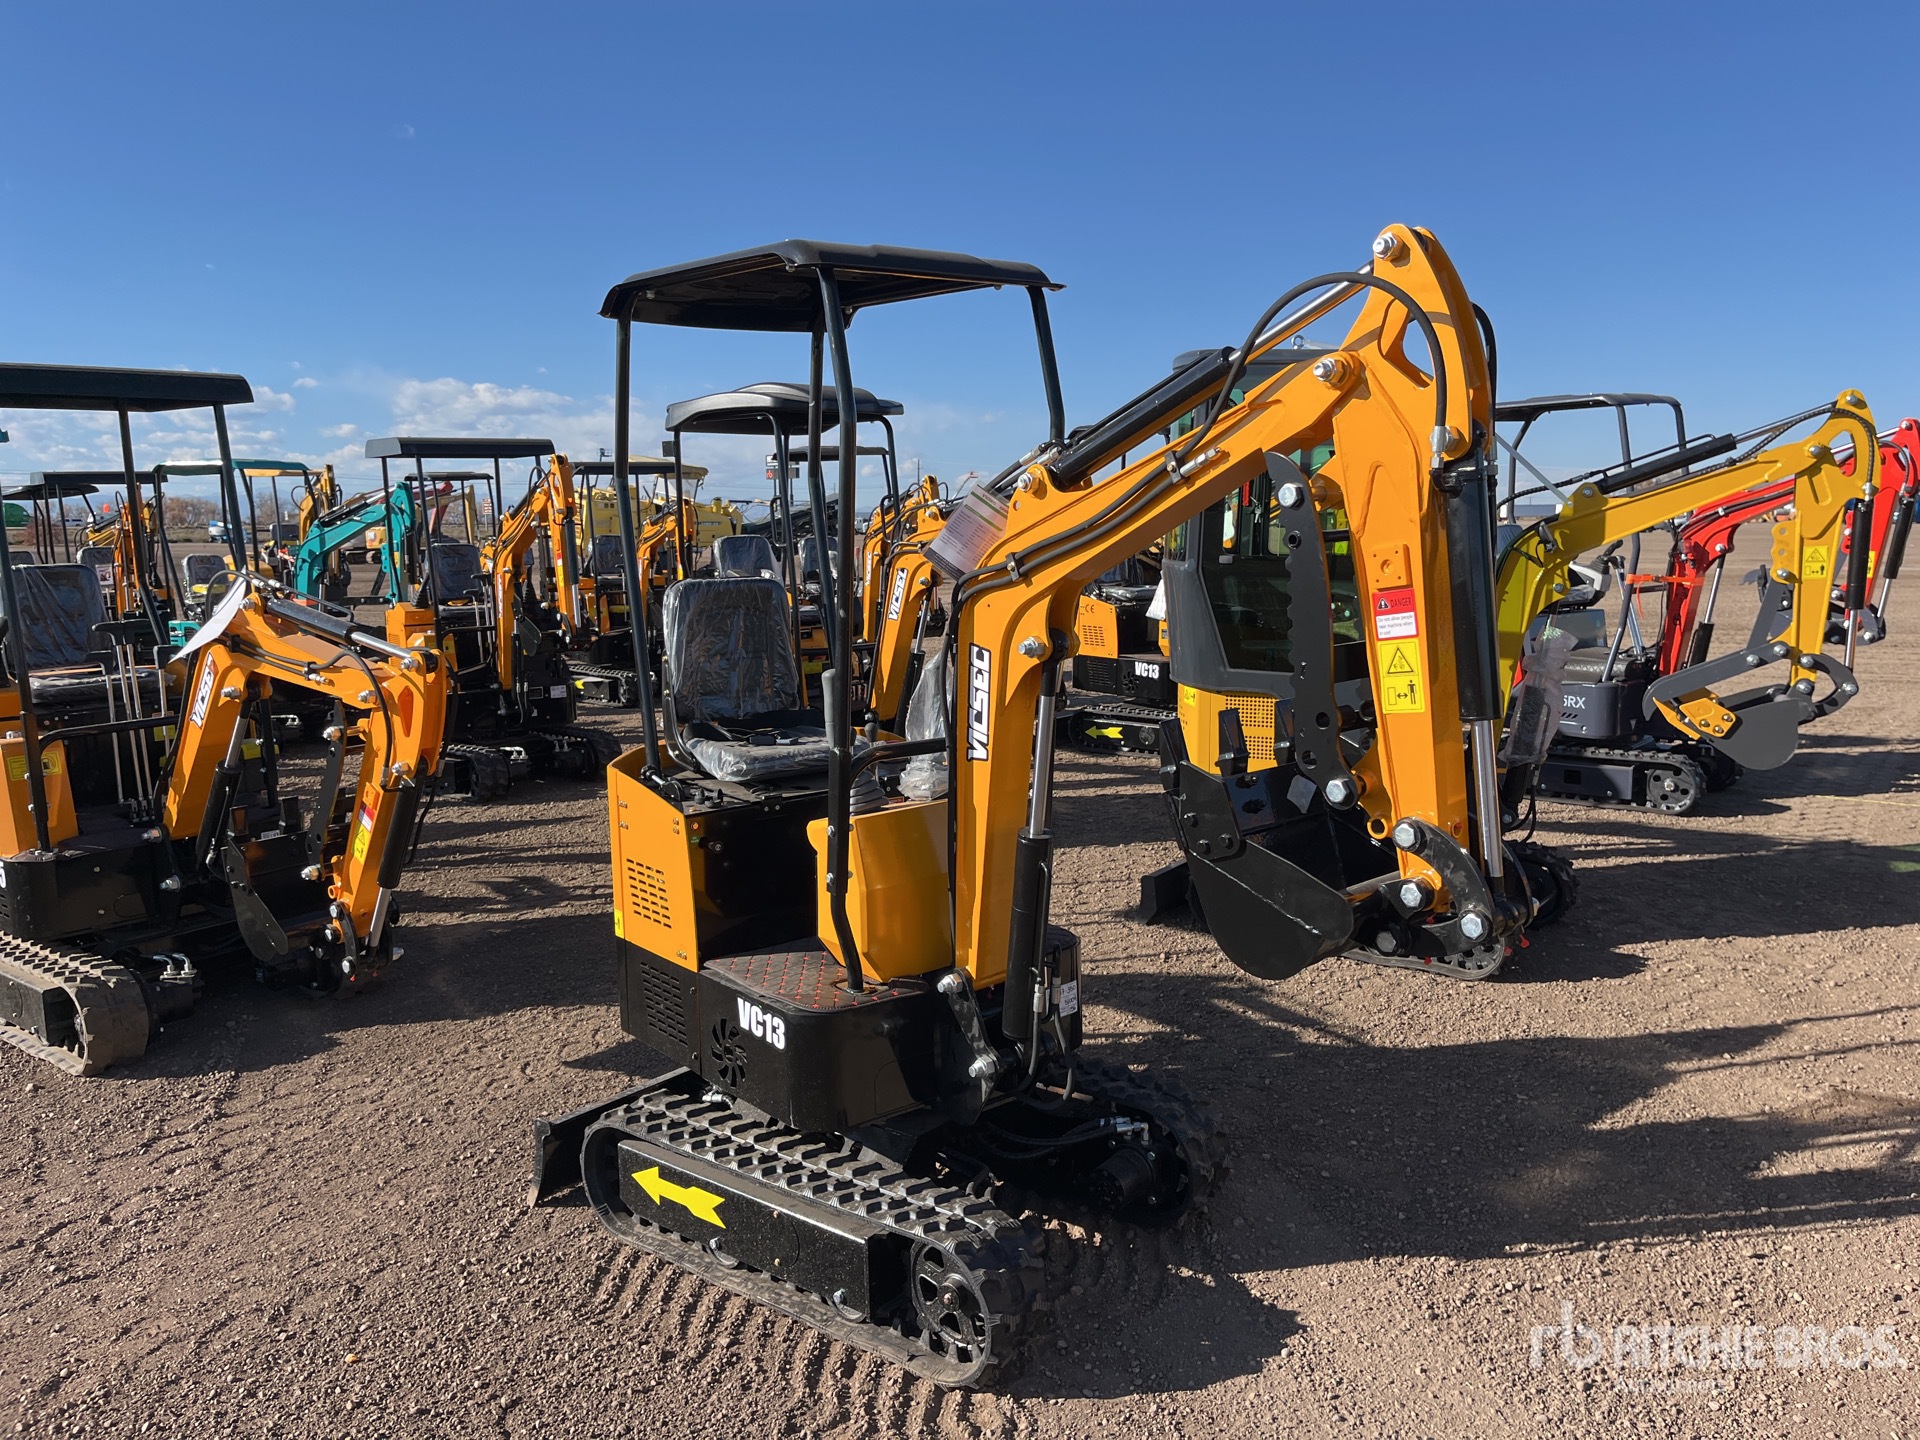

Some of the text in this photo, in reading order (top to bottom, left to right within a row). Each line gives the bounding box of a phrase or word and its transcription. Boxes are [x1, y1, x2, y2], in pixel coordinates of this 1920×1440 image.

[1390, 597, 1411, 607] DANGER
[1134, 661, 1160, 679] VC13
[967, 643, 991, 761] VICSEC
[737, 996, 786, 1050] VC13
